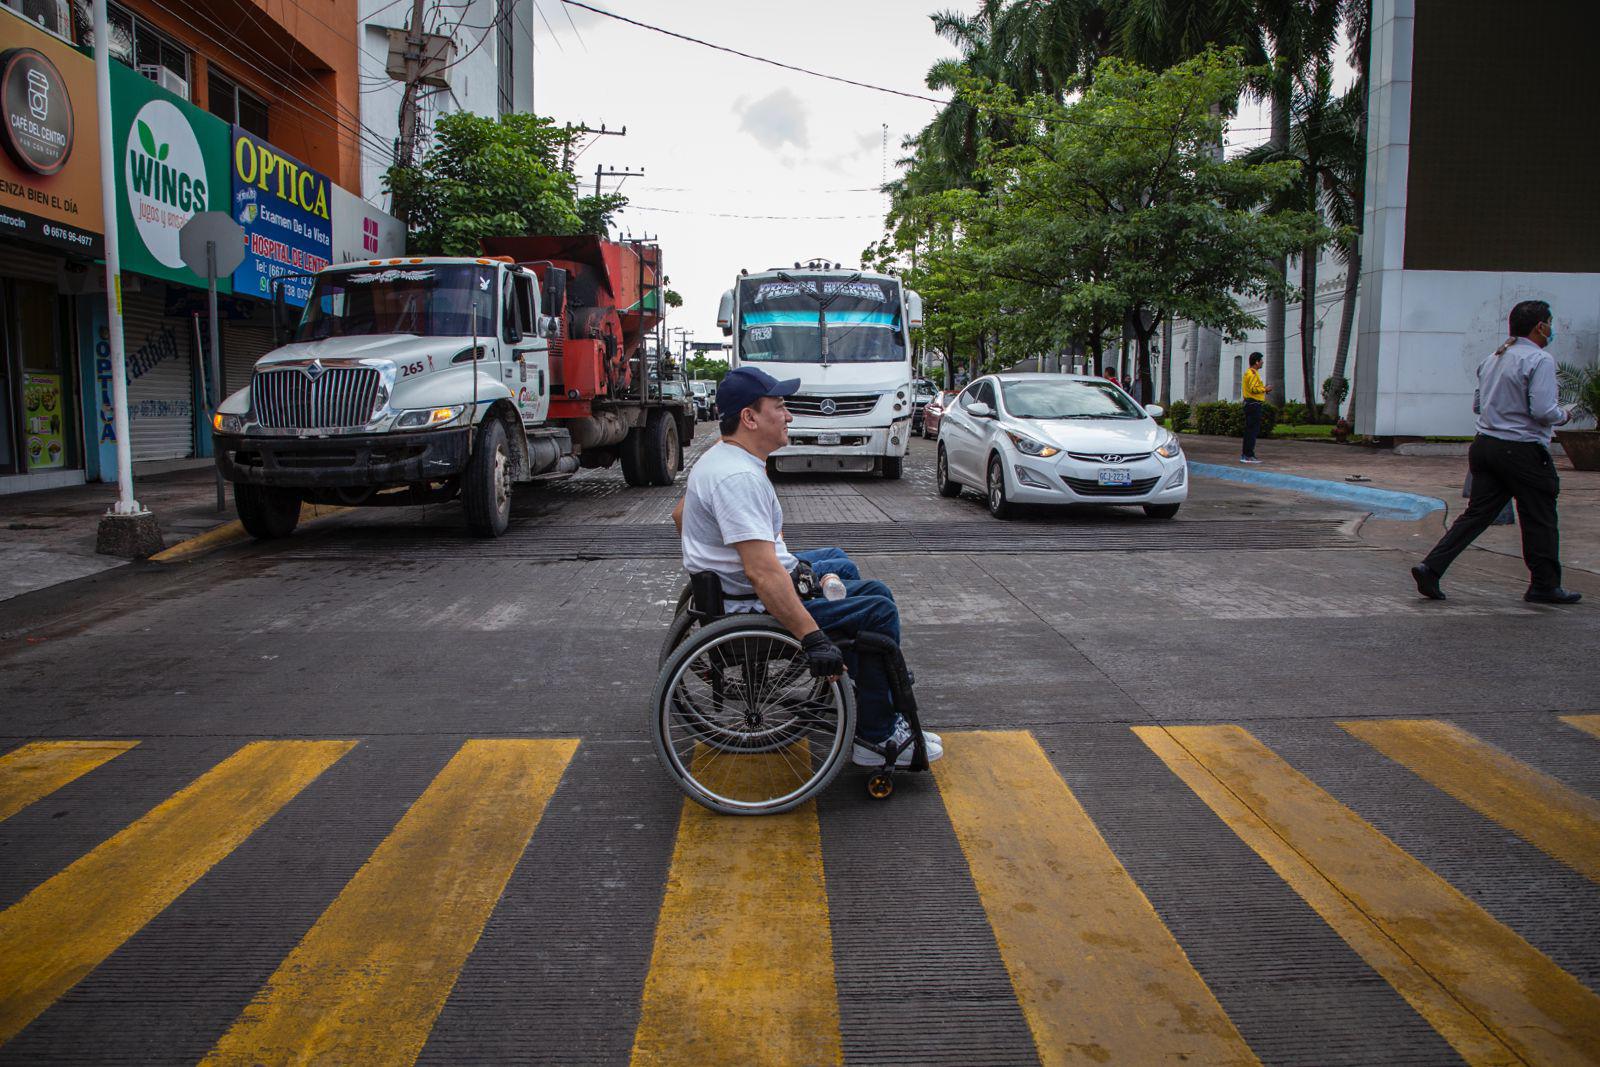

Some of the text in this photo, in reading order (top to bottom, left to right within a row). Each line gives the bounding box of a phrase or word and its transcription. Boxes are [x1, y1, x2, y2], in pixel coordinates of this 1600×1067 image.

[11, 114, 66, 146] CAFÉ DEL CENTRO
[130, 149, 206, 213] WINGS
[235, 136, 330, 220] OPTICA
[27, 187, 49, 206] BIEN
[51, 196, 62, 209] EL
[64, 198, 78, 214] DÍA
[139, 198, 160, 223] jugos
[260, 204, 330, 247] Examen De La Vista
[251, 232, 291, 265] HOSPITAL
[291, 247, 303, 269] DE
[256, 259, 267, 274] Tel:
[400, 360, 425, 377] 265
